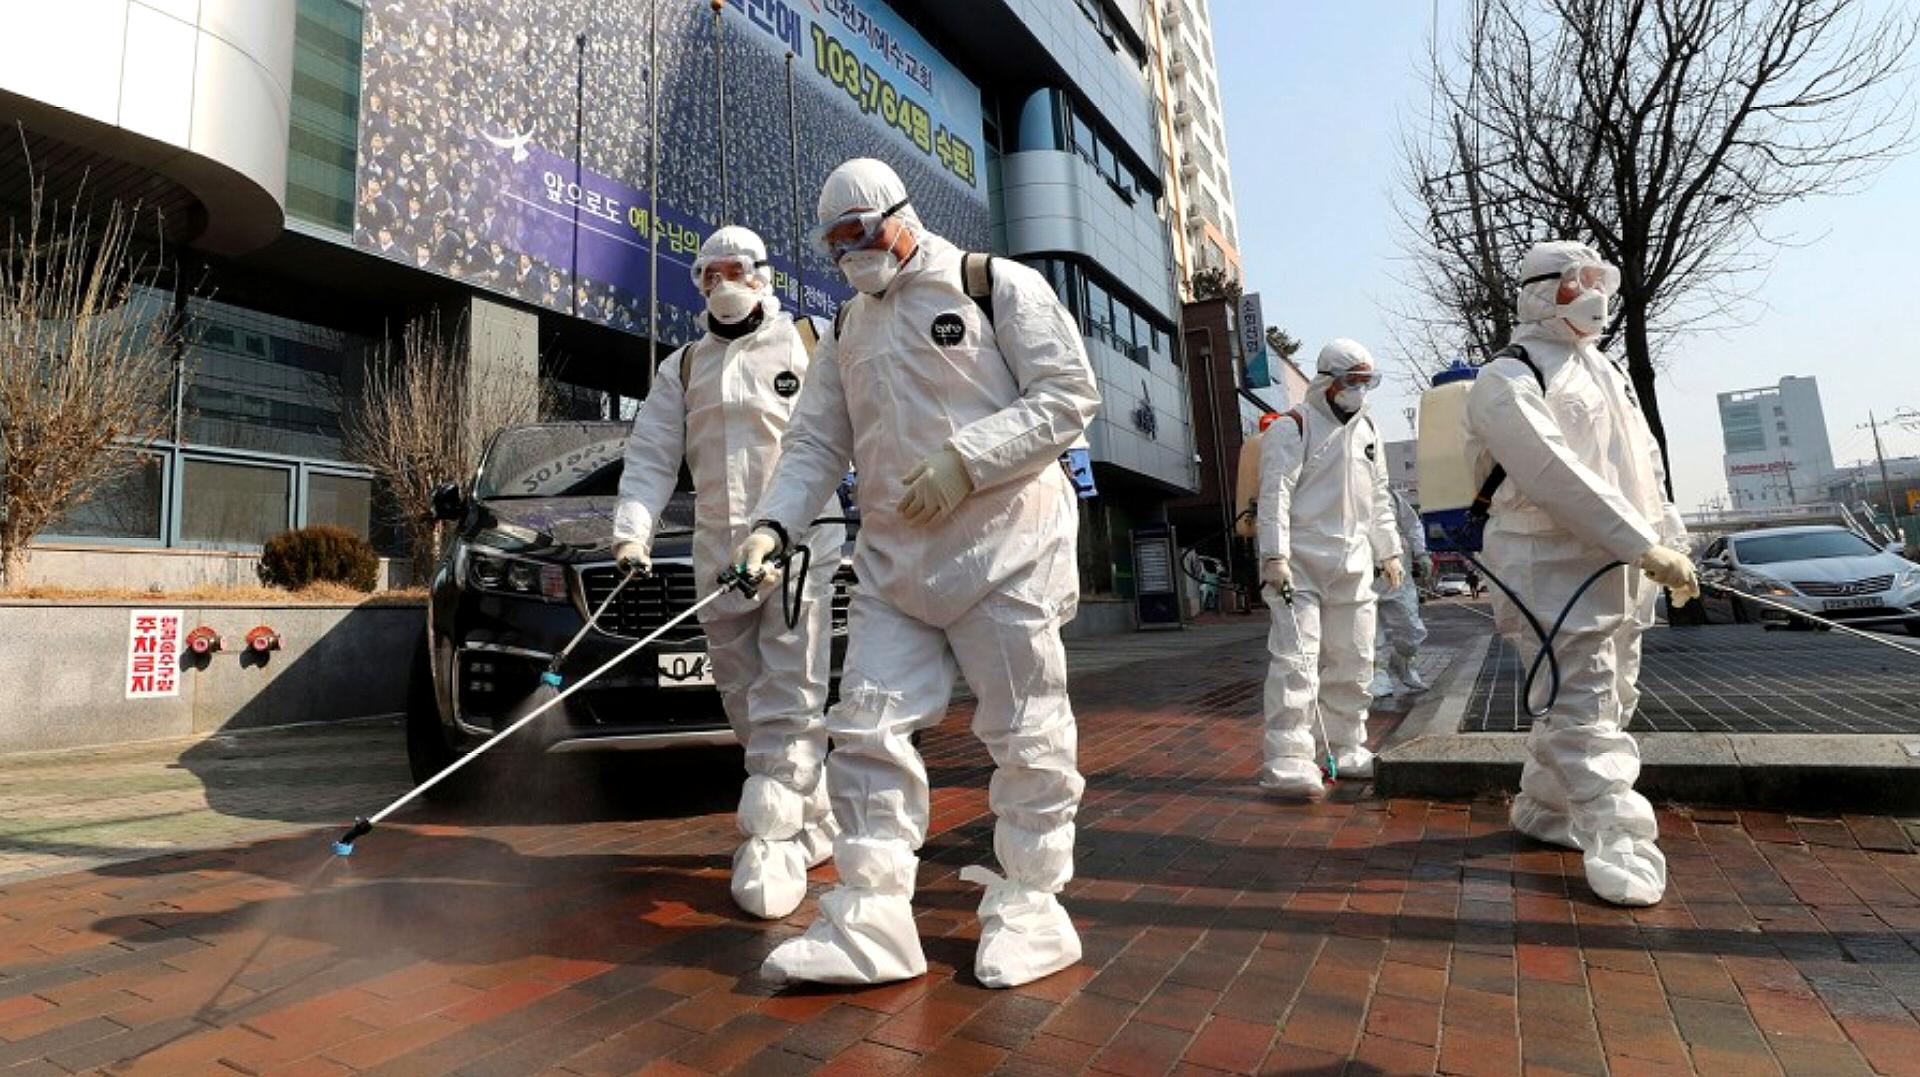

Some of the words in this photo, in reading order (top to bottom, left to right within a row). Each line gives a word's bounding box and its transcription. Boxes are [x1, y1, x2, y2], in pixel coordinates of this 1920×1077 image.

[810, 20, 932, 156] 103,764명
[935, 122, 977, 188] 수료!
[543, 171, 623, 225] 앞으로도
[131, 616, 157, 692] 주차금지
